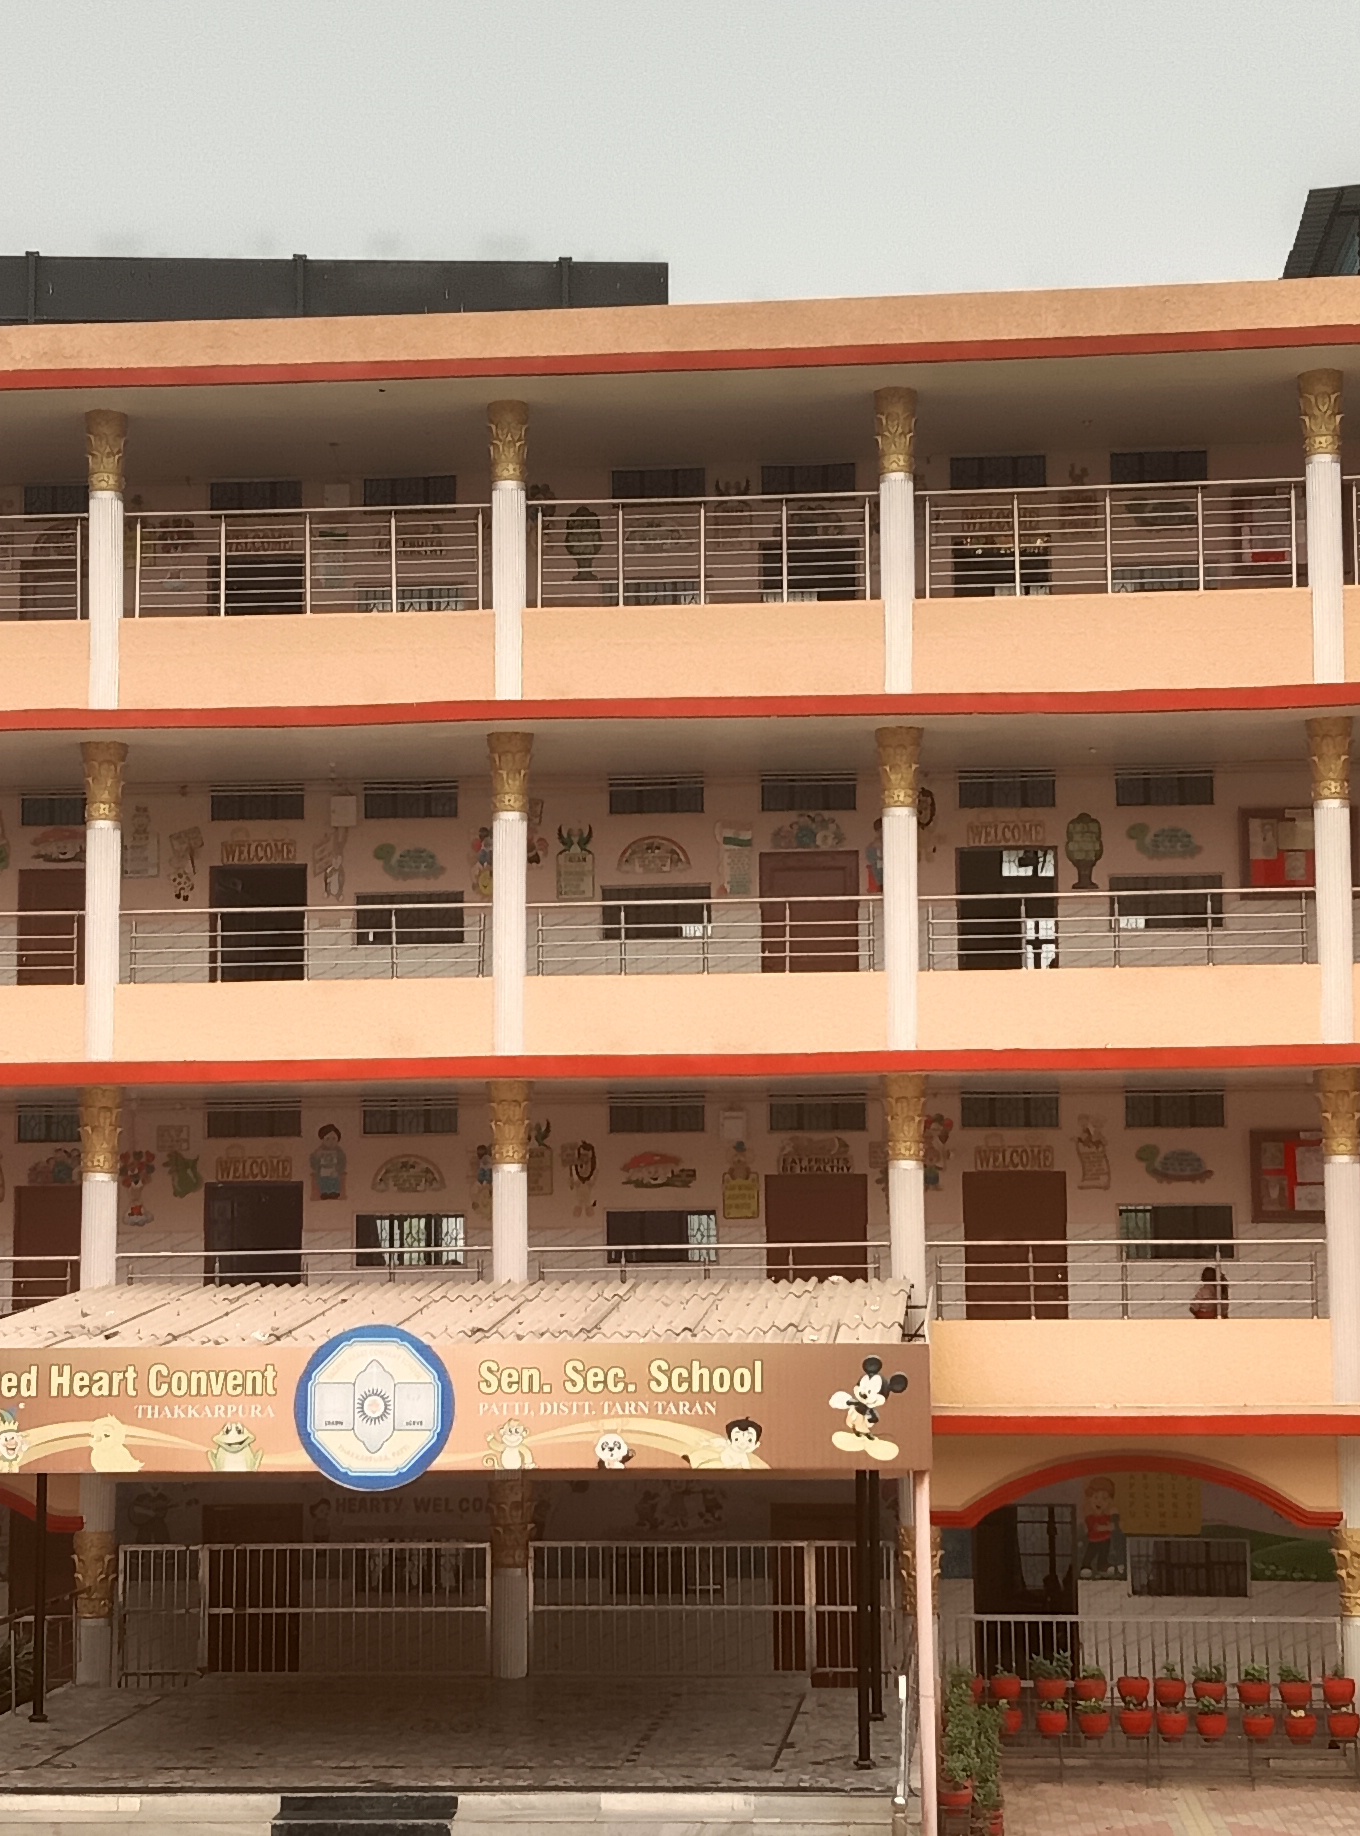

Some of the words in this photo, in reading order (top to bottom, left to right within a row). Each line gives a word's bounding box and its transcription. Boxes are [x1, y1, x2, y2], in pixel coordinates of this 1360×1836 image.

[969, 823, 1043, 845] WELCOME
[223, 841, 295, 863] WELCOME
[219, 1158, 291, 1179] WELCOME
[781, 1165, 795, 1173] BE
[800, 1165, 852, 1173] HEALTHY
[782, 1157, 803, 1165] EAT
[807, 1157, 850, 1165] FRUITS
[978, 1148, 1053, 1169] WELCOME
[48, 1363, 139, 1399] Heart
[147, 1362, 279, 1399] Convent
[477, 1358, 553, 1395] Sen.
[562, 1358, 637, 1395] Sec.
[648, 1357, 764, 1394] School
[134, 1404, 275, 1419] THAKKARPURA
[539, 1401, 596, 1416] DISTT.
[600, 1401, 650, 1416] TARN
[654, 1400, 717, 1416] TARAN
[336, 1498, 403, 1514] HEARTY
[412, 1497, 491, 1514] WELCO
